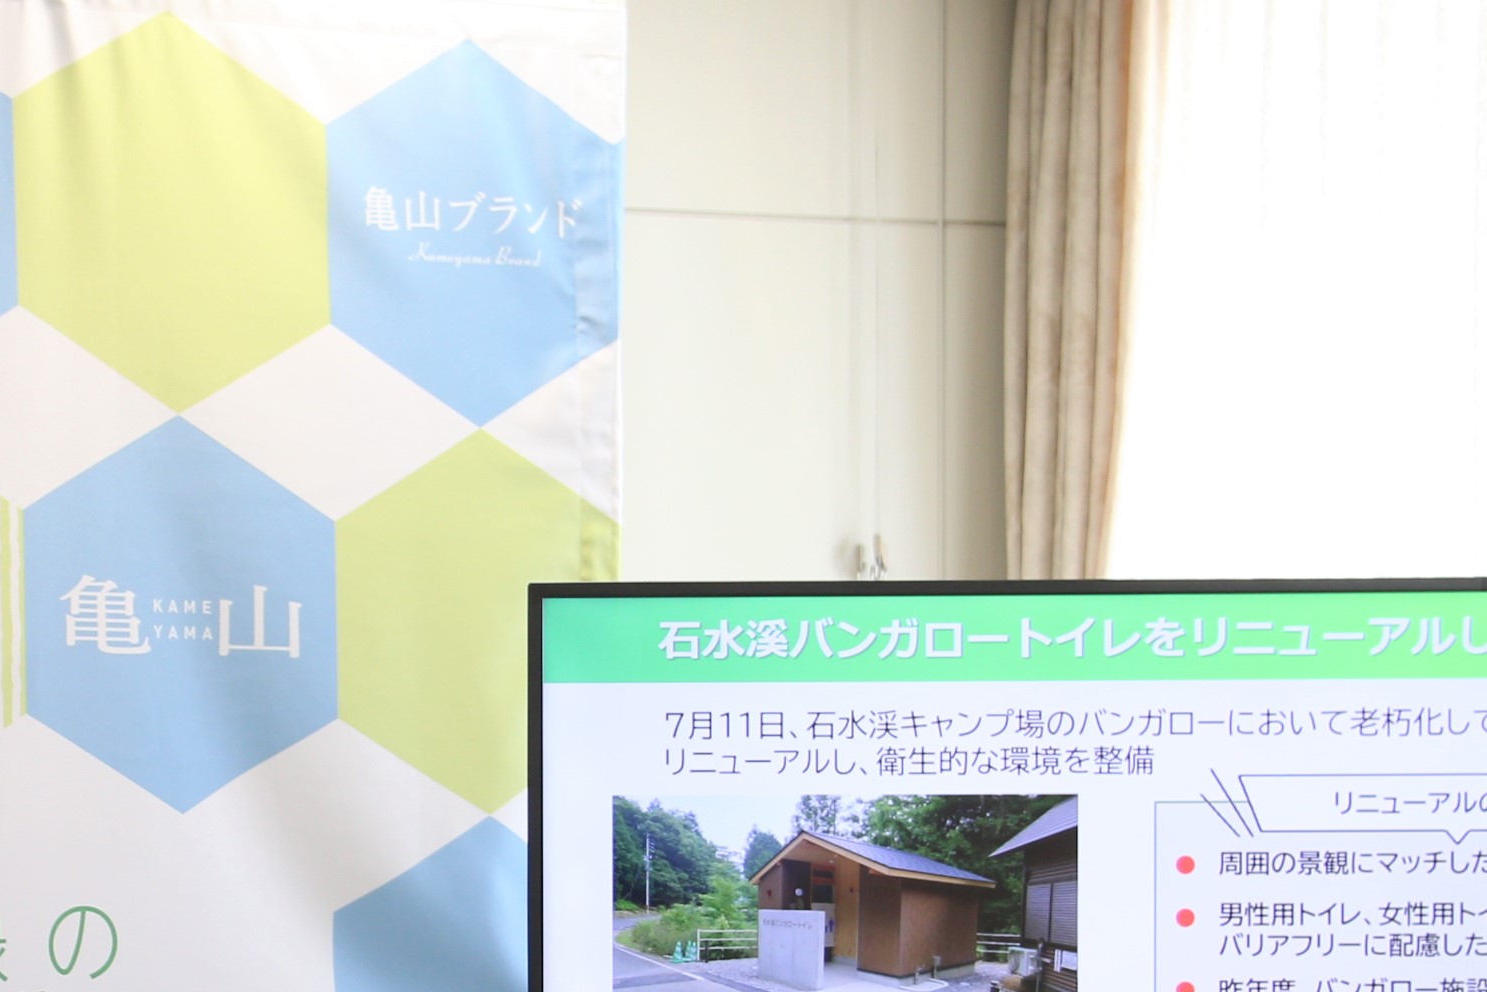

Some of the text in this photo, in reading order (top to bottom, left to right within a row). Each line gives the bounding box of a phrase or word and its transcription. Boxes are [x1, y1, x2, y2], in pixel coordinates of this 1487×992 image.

[364, 186, 584, 239] 亀山ブランド
[407, 242, 542, 268] Kameyama Brand
[152, 598, 213, 615] KAME
[153, 625, 214, 640] YAMA
[664, 744, 1155, 777] リニューアルし、衛生的な環境を整備
